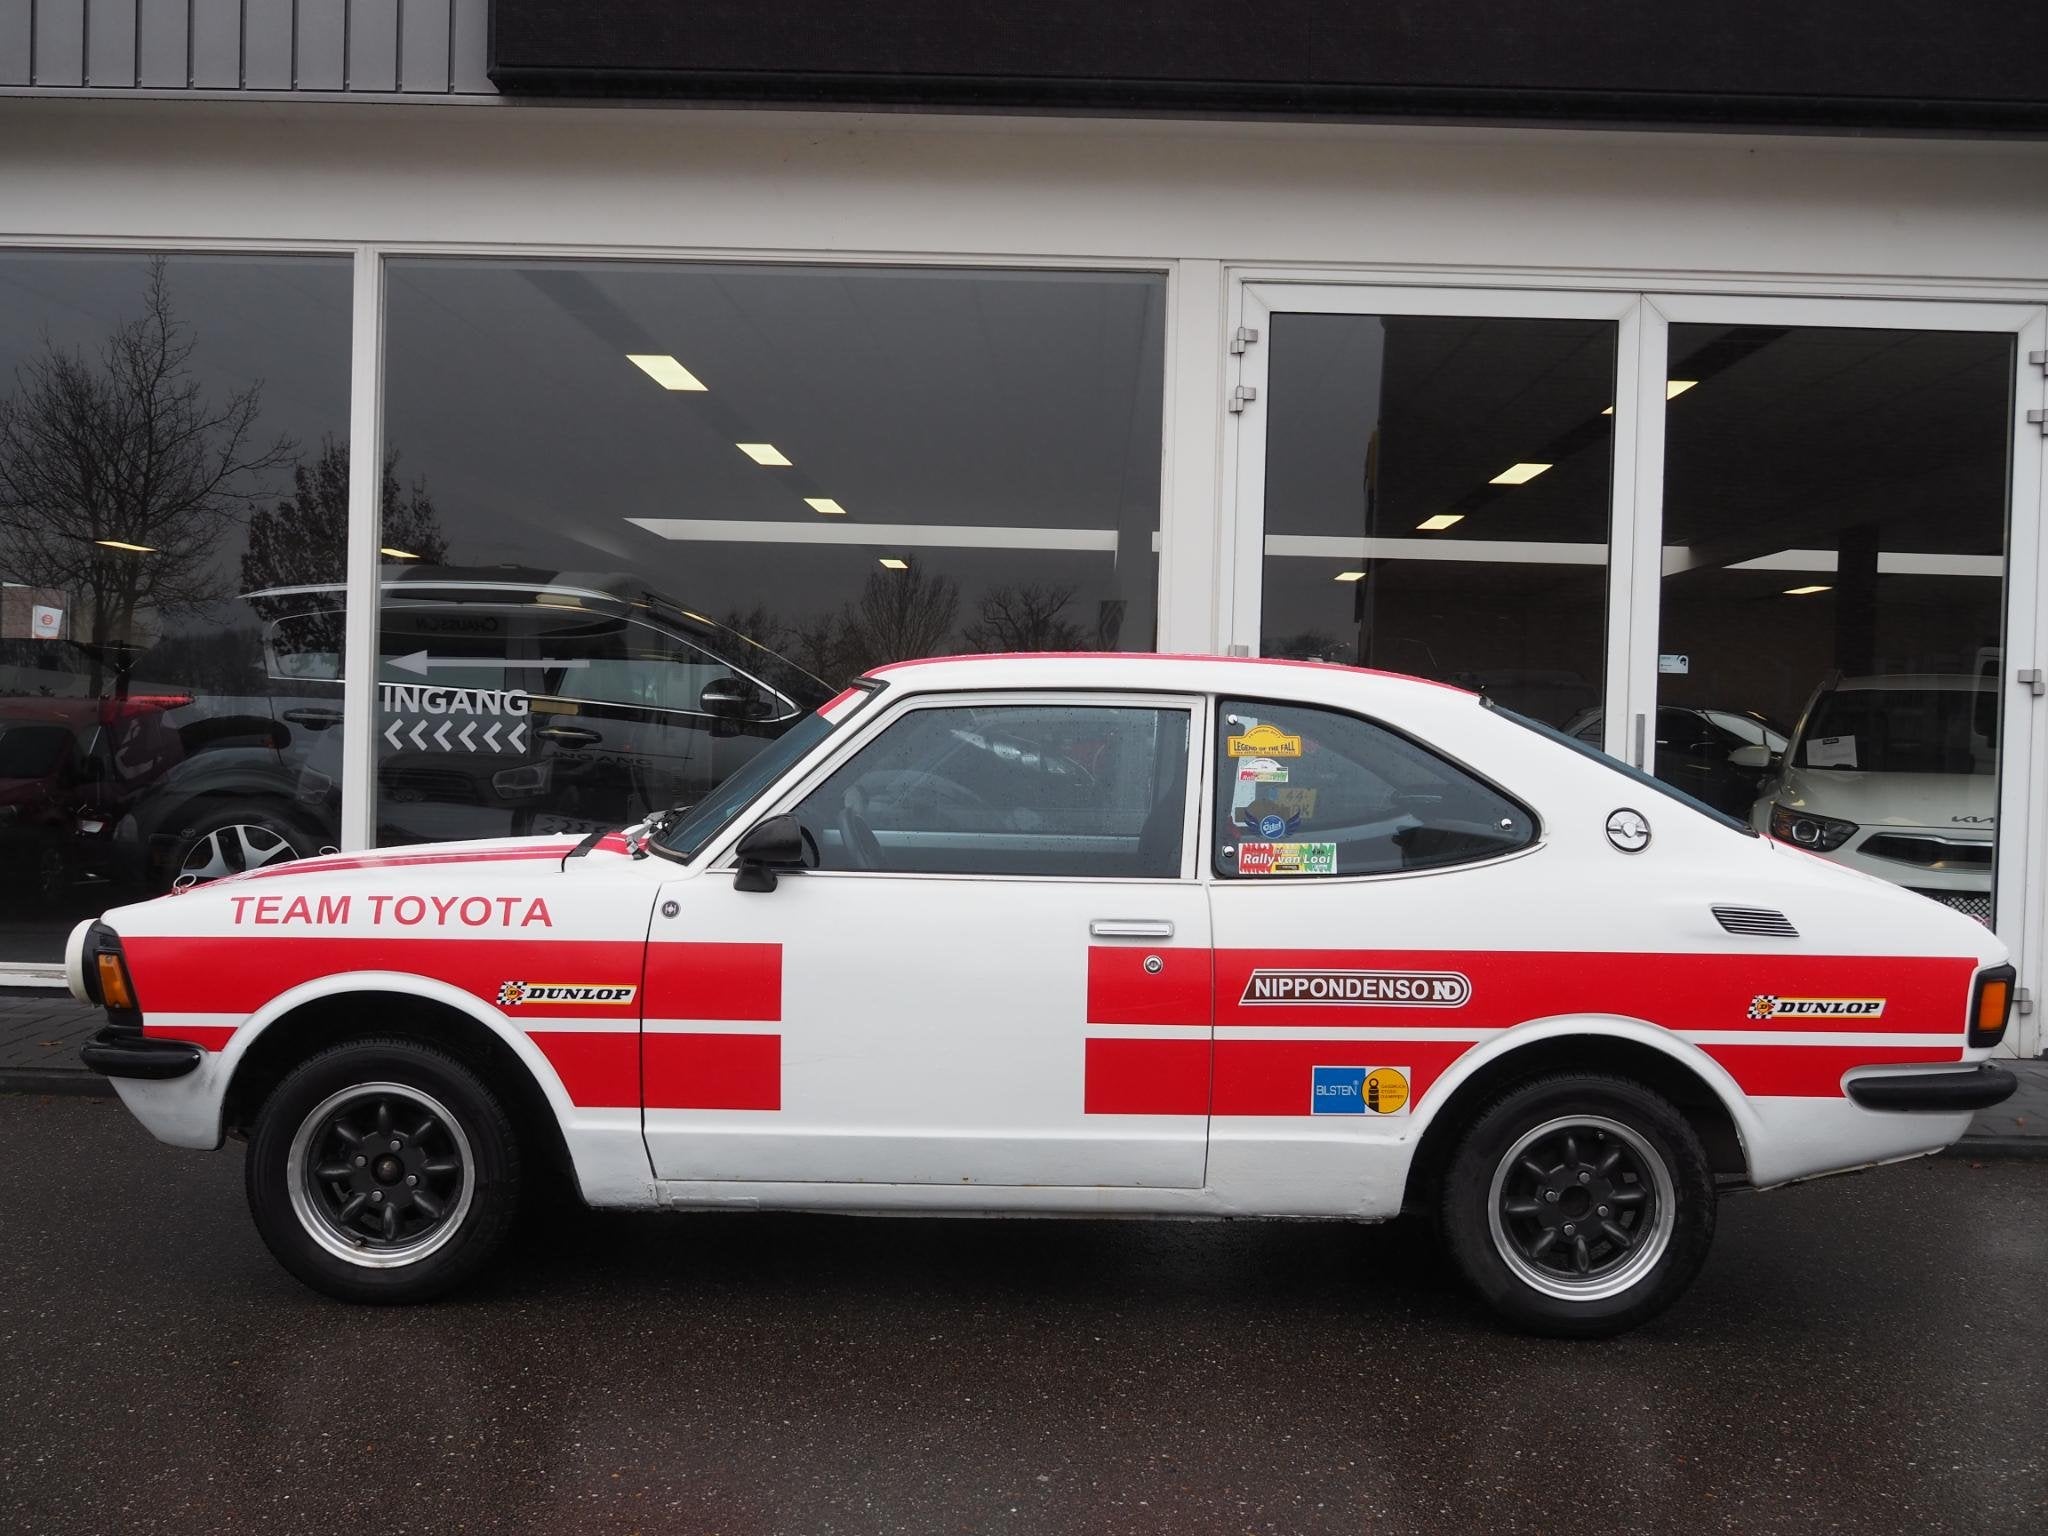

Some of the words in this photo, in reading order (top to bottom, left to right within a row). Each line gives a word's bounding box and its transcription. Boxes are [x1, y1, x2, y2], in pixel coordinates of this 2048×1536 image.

[384, 686, 529, 716] INGANG
[1234, 740, 1257, 751] LEGEND
[1280, 740, 1295, 752] FALL
[1243, 853, 1274, 867] Rally
[1277, 856, 1300, 864] van
[1303, 853, 1331, 864] Looi
[230, 895, 351, 924] TEAM
[367, 895, 553, 927] TOYOTA
[526, 988, 632, 1000] DUNLOP
[1255, 978, 1430, 999] NIPPONDENSO
[1777, 1002, 1880, 1014] DUNLOP
